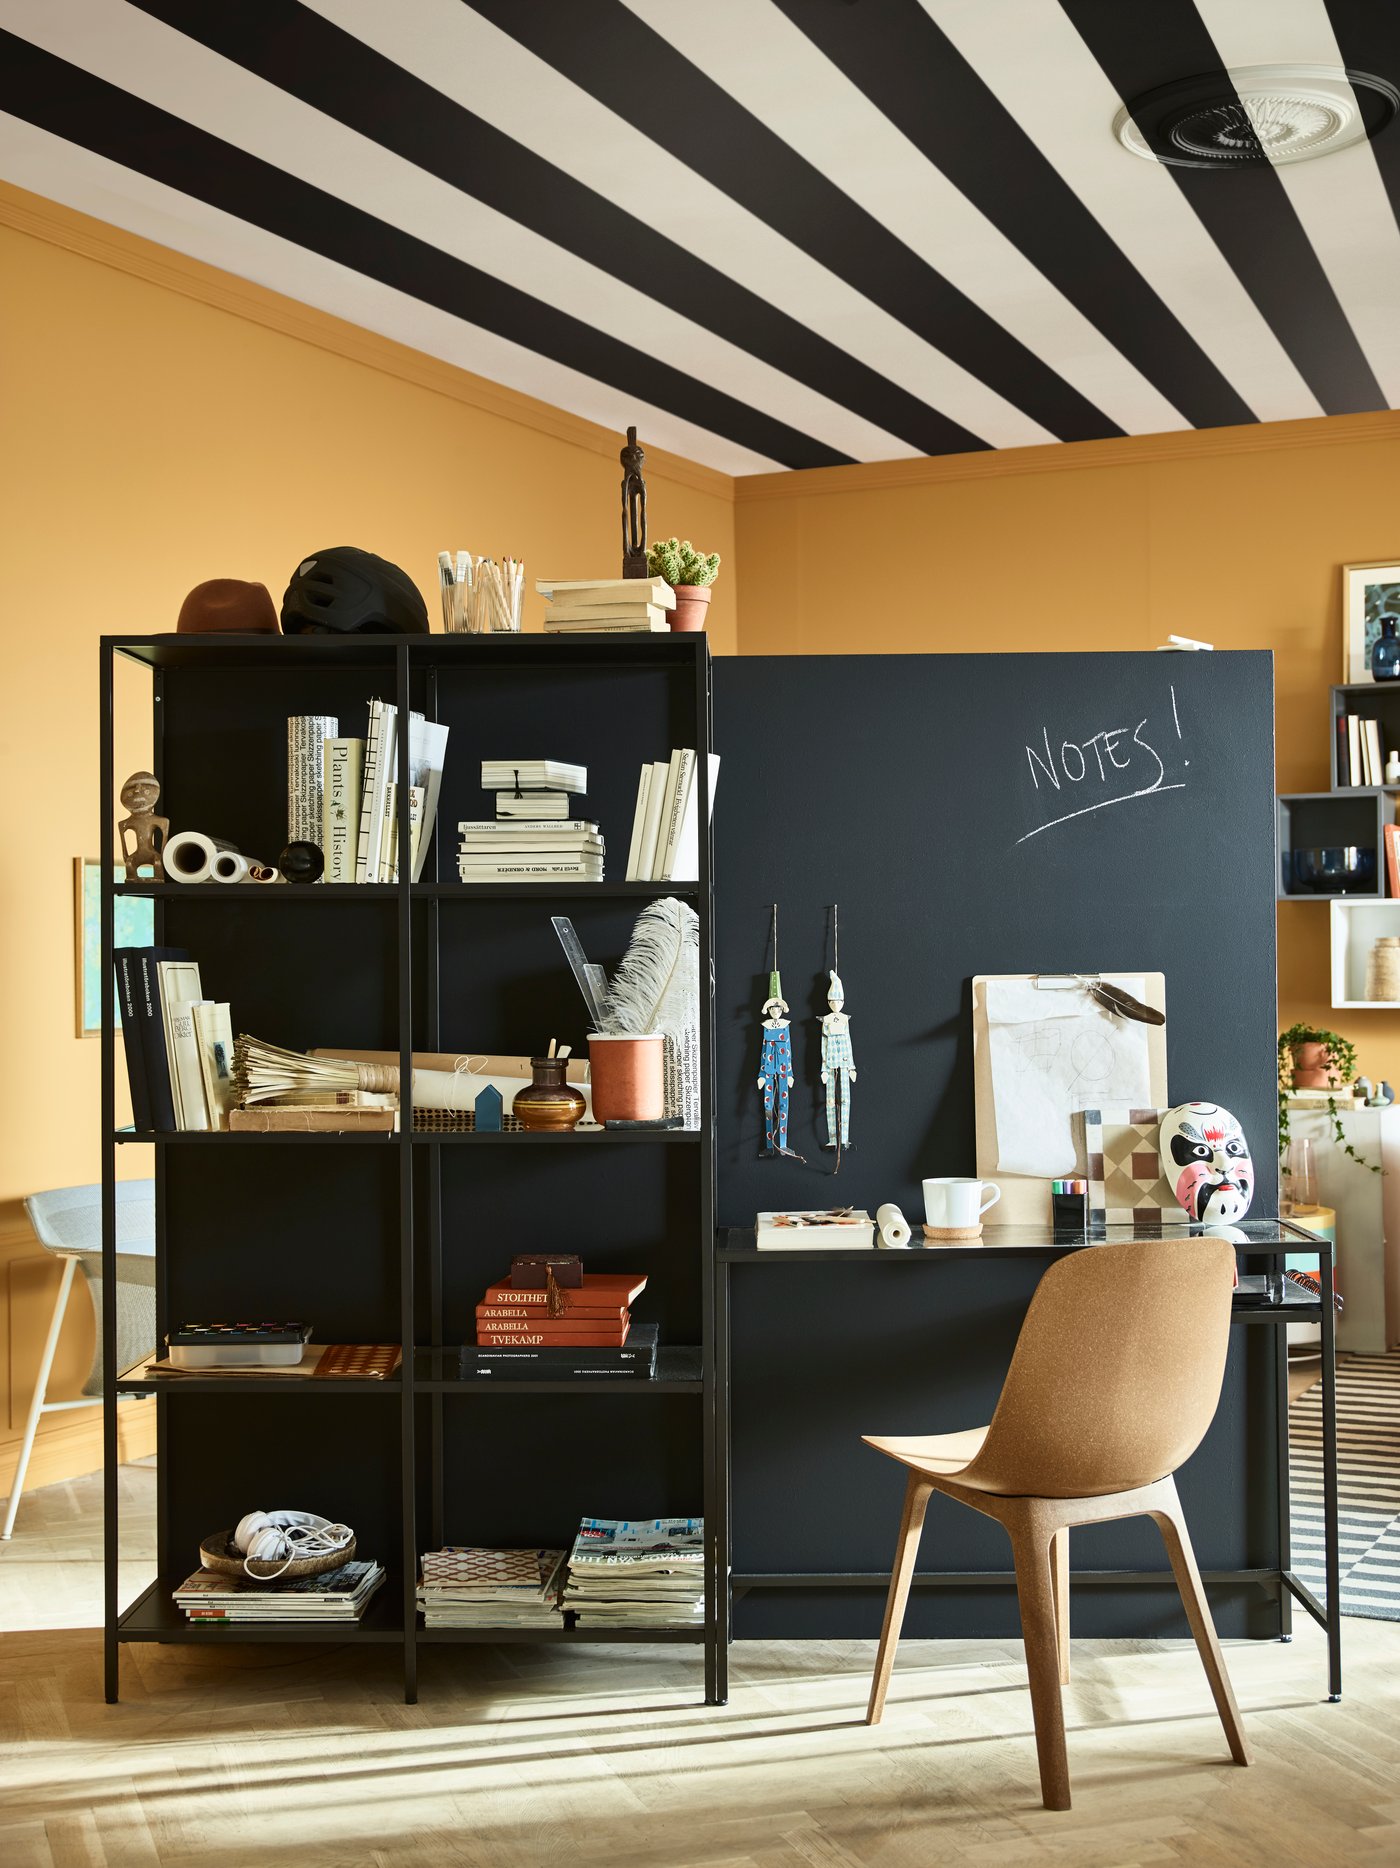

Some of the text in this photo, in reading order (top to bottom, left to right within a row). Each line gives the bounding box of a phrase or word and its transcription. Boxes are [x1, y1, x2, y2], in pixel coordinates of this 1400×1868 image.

[315, 744, 323, 778] sketching
[330, 746, 348, 880] Plants History
[497, 1293, 548, 1302] STOLTHET
[490, 1335, 544, 1345] TVEKAMP
